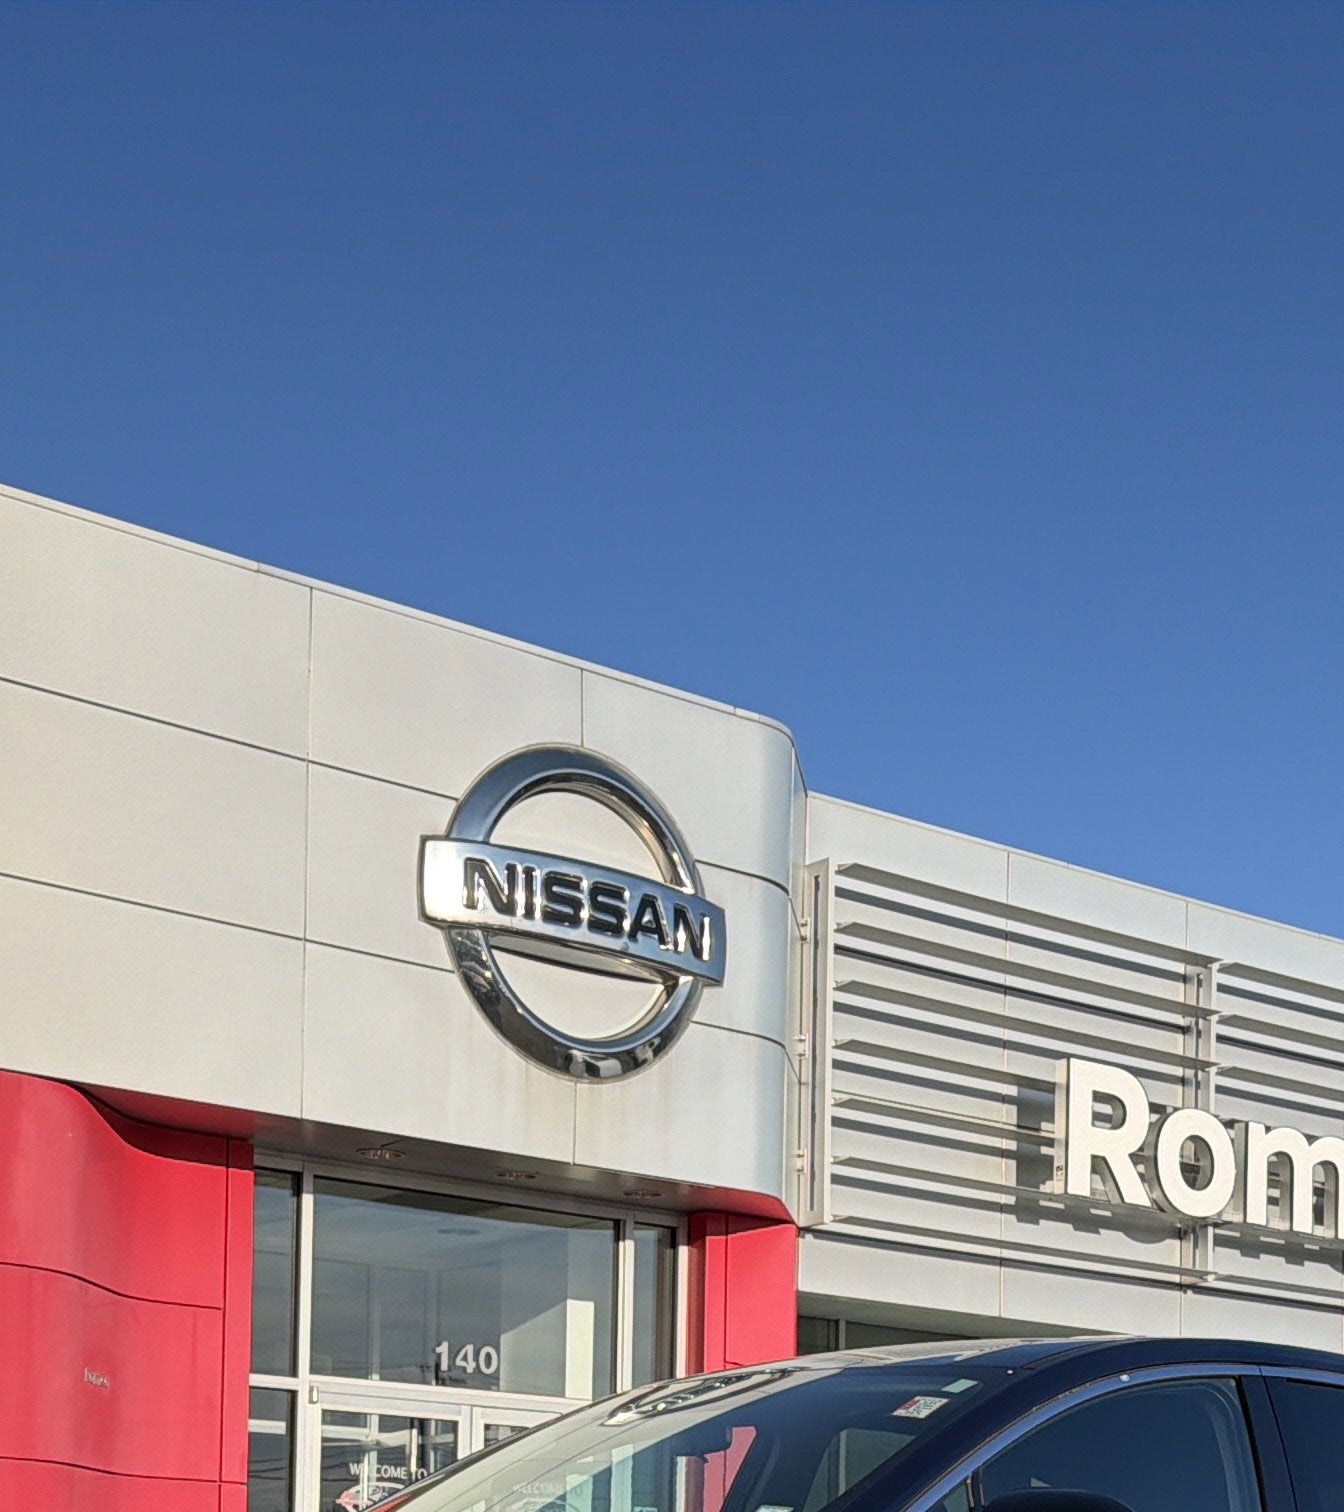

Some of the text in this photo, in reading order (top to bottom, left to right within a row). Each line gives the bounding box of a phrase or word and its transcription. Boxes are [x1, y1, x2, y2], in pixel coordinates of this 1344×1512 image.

[462, 857, 711, 962] NISSAN
[435, 1341, 498, 1375] 140
[349, 1462, 408, 1480] WCOME
